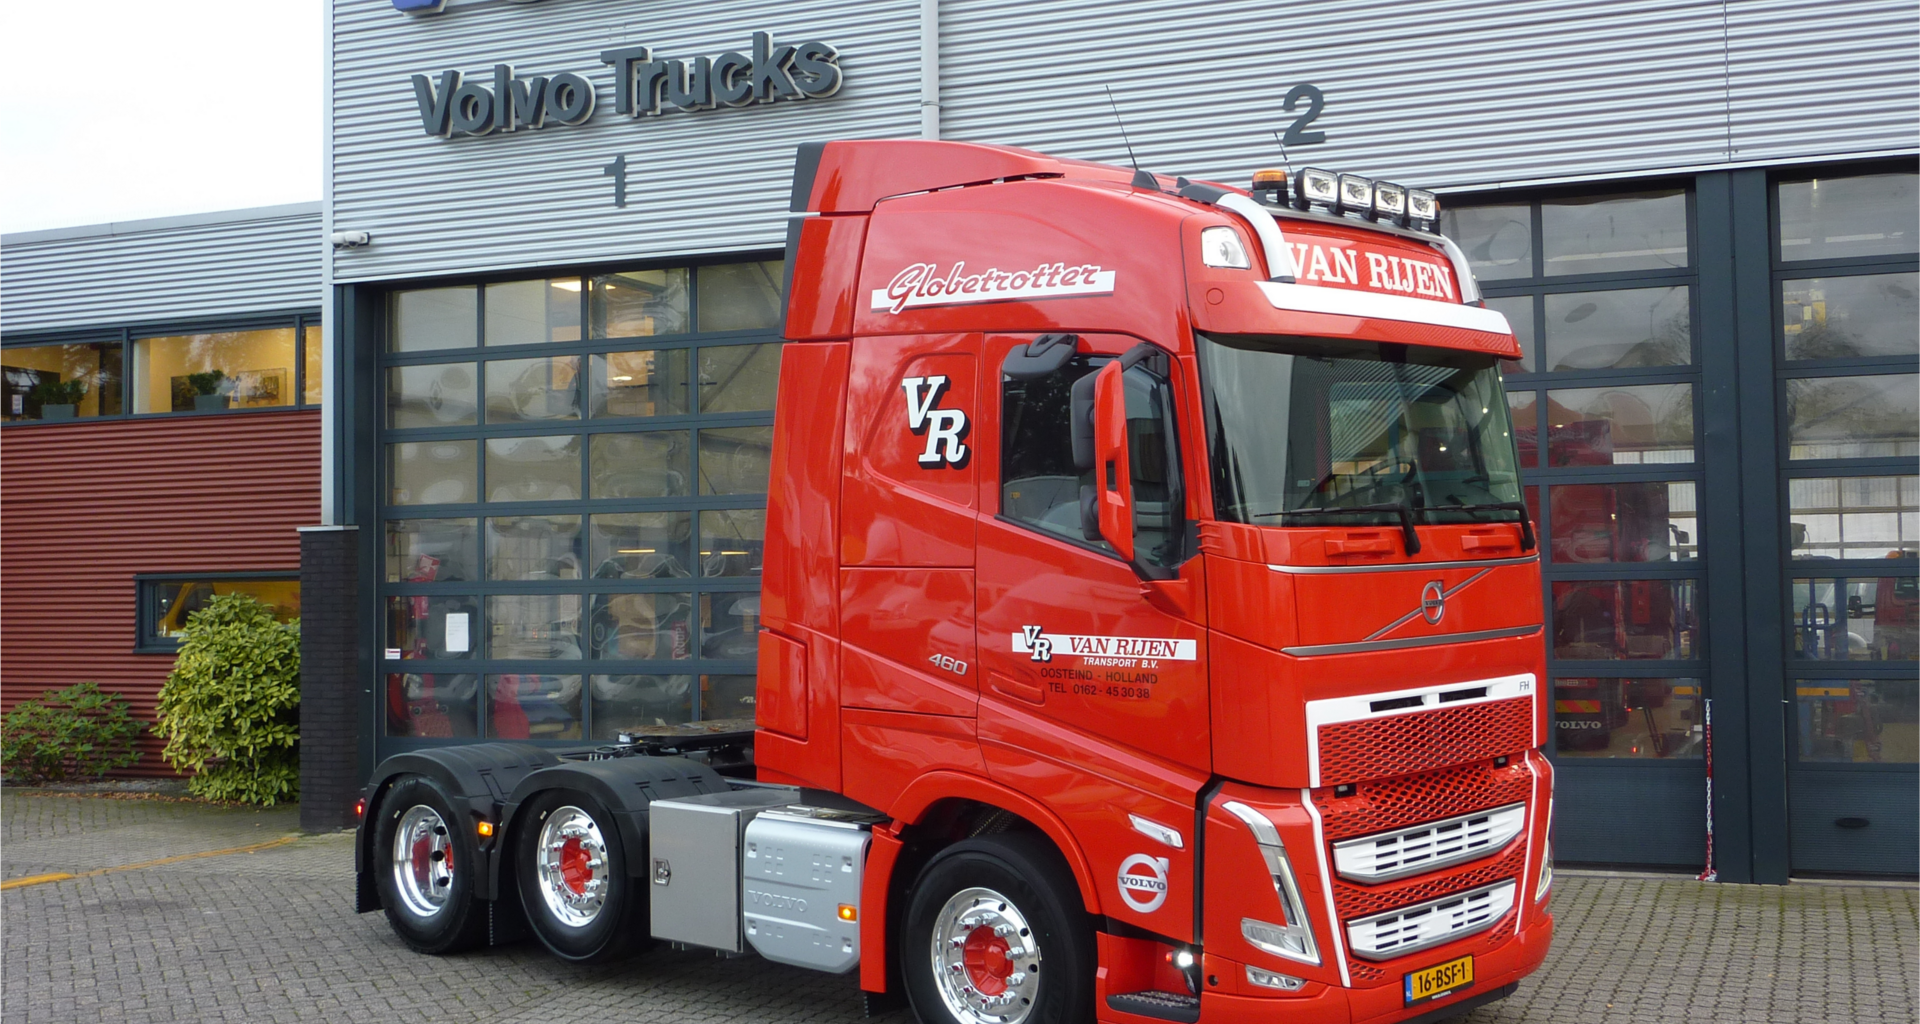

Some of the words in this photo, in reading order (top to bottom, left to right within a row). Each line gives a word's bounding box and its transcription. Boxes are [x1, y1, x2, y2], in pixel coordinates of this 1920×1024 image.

[411, 63, 596, 138] Volvo
[601, 31, 843, 117] Trucks
[1282, 83, 1326, 146] 2
[604, 155, 626, 208] 1
[1284, 241, 1358, 285] VAN
[1365, 252, 1453, 299] RIJEN
[887, 261, 1101, 314] Globetrotter
[1069, 637, 1111, 655] VAN
[1114, 639, 1179, 657] RIJEN
[928, 653, 968, 676] 460
[1083, 657, 1137, 668] TRANSPORT
[1141, 660, 1159, 669] B.V.
[1040, 668, 1093, 681] OOSTEIND
[1105, 672, 1158, 684] HOLLAND
[1519, 681, 1530, 691] FH
[1048, 682, 1067, 693] TEL
[1073, 684, 1097, 696] 0162
[1119, 876, 1166, 891] VOLVO
[748, 889, 808, 913] VOLVO
[1418, 961, 1466, 994] 16-BSF-1
